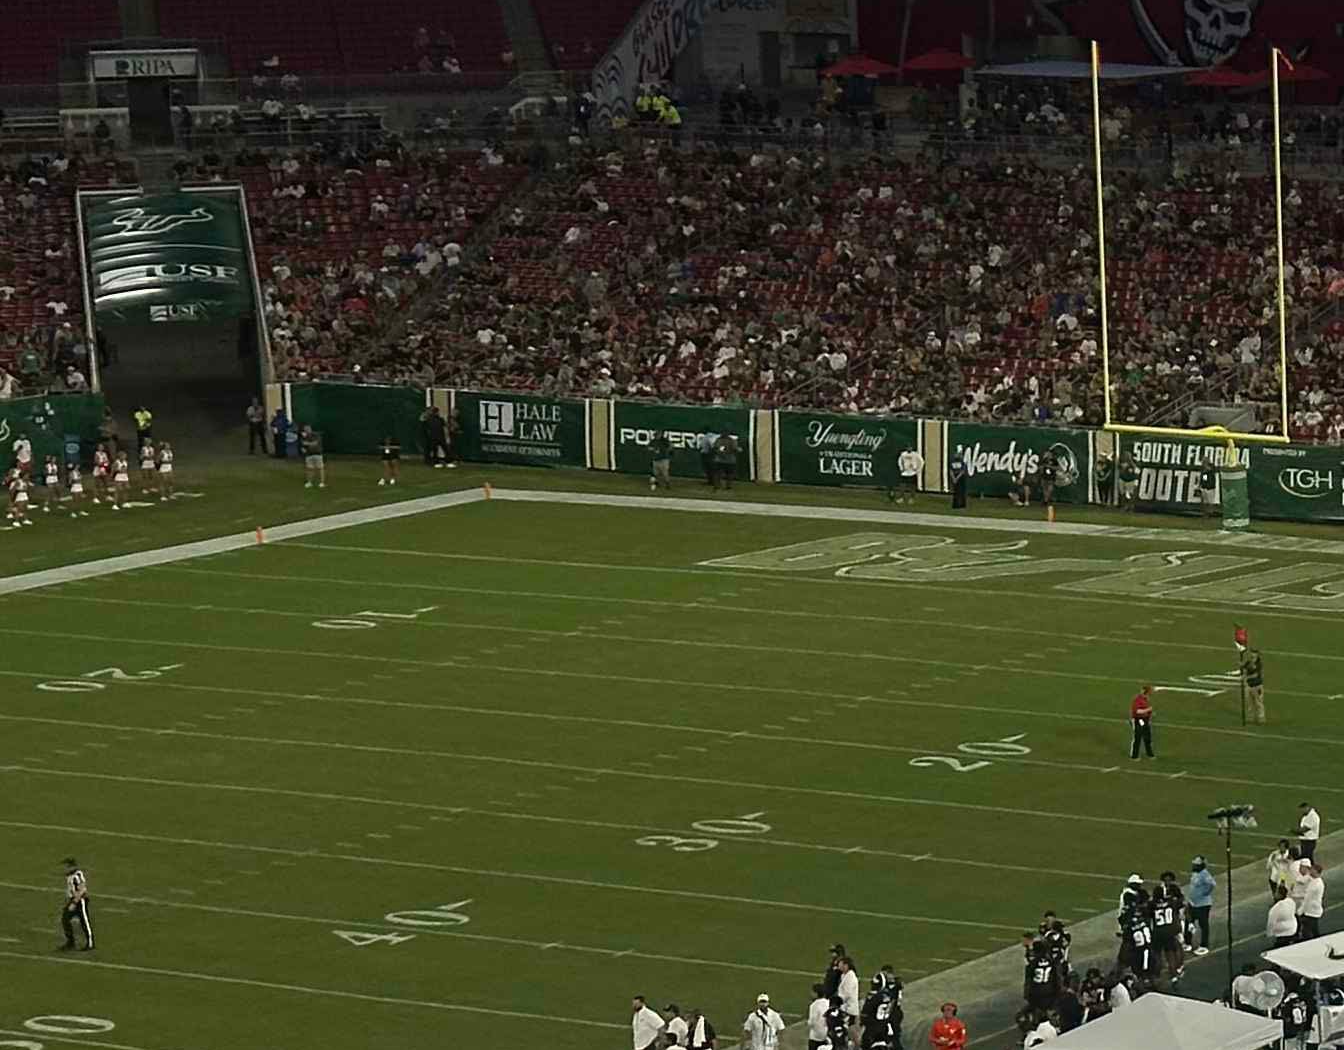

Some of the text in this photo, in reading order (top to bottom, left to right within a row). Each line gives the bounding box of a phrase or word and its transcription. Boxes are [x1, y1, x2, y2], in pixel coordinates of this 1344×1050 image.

[153, 263, 239, 279] USF
[515, 402, 562, 423] HALE
[519, 422, 558, 441] LAW
[806, 420, 887, 450] Yuengling
[957, 440, 1039, 481] Wendy's
[1133, 441, 1182, 465] SOUTH
[819, 457, 874, 478] LAGER
[1286, 468, 1334, 491] TGH
[635, 819, 772, 853] 30
[333, 908, 470, 946] 40
